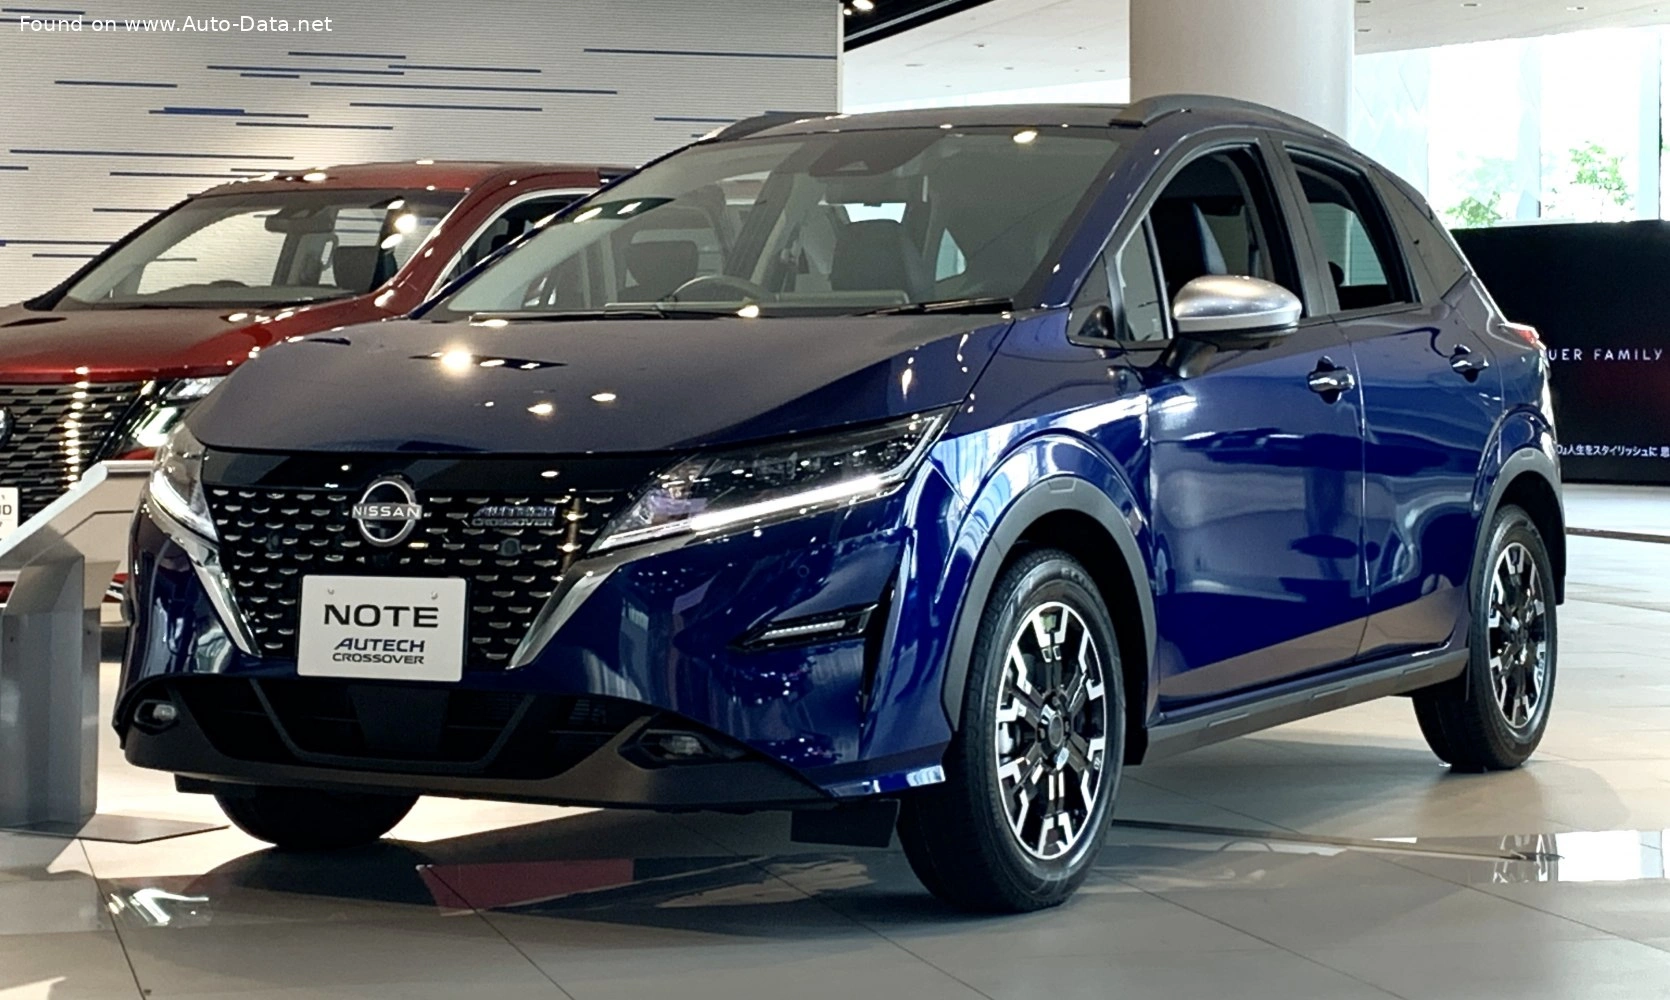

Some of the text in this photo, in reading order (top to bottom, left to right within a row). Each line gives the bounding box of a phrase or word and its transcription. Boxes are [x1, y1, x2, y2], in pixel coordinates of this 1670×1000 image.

[1547, 348, 1663, 361] UER FAMILY
[352, 504, 421, 519] NISSAN
[323, 603, 440, 629] NOTE
[333, 637, 426, 653] AUTECH
[332, 652, 425, 665] CROSSOVER
